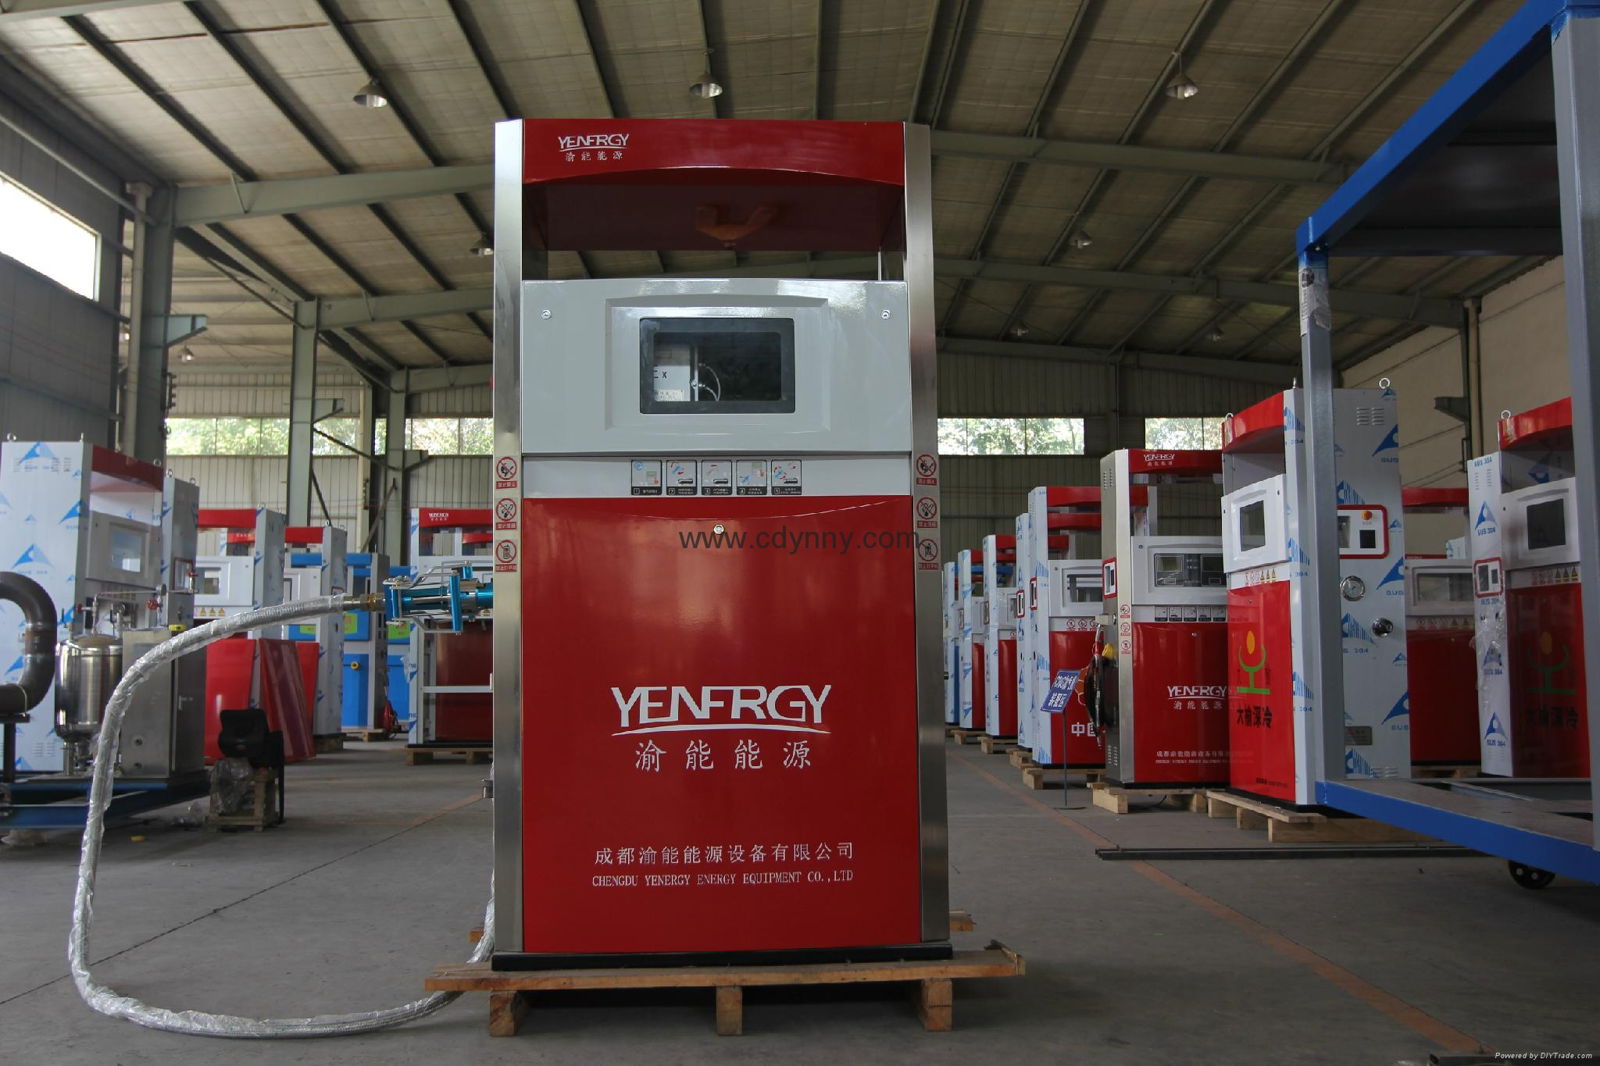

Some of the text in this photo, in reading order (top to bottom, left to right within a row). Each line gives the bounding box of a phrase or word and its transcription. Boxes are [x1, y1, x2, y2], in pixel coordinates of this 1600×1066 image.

[634, 739, 813, 773] 渝能能源
[595, 842, 854, 865] 成都渝能能源设备有限公司
[592, 875, 638, 887] CHENGDU
[645, 874, 691, 886] YENERGY
[697, 873, 736, 885] ENERGY
[743, 871, 802, 884] EQUIPMENT
